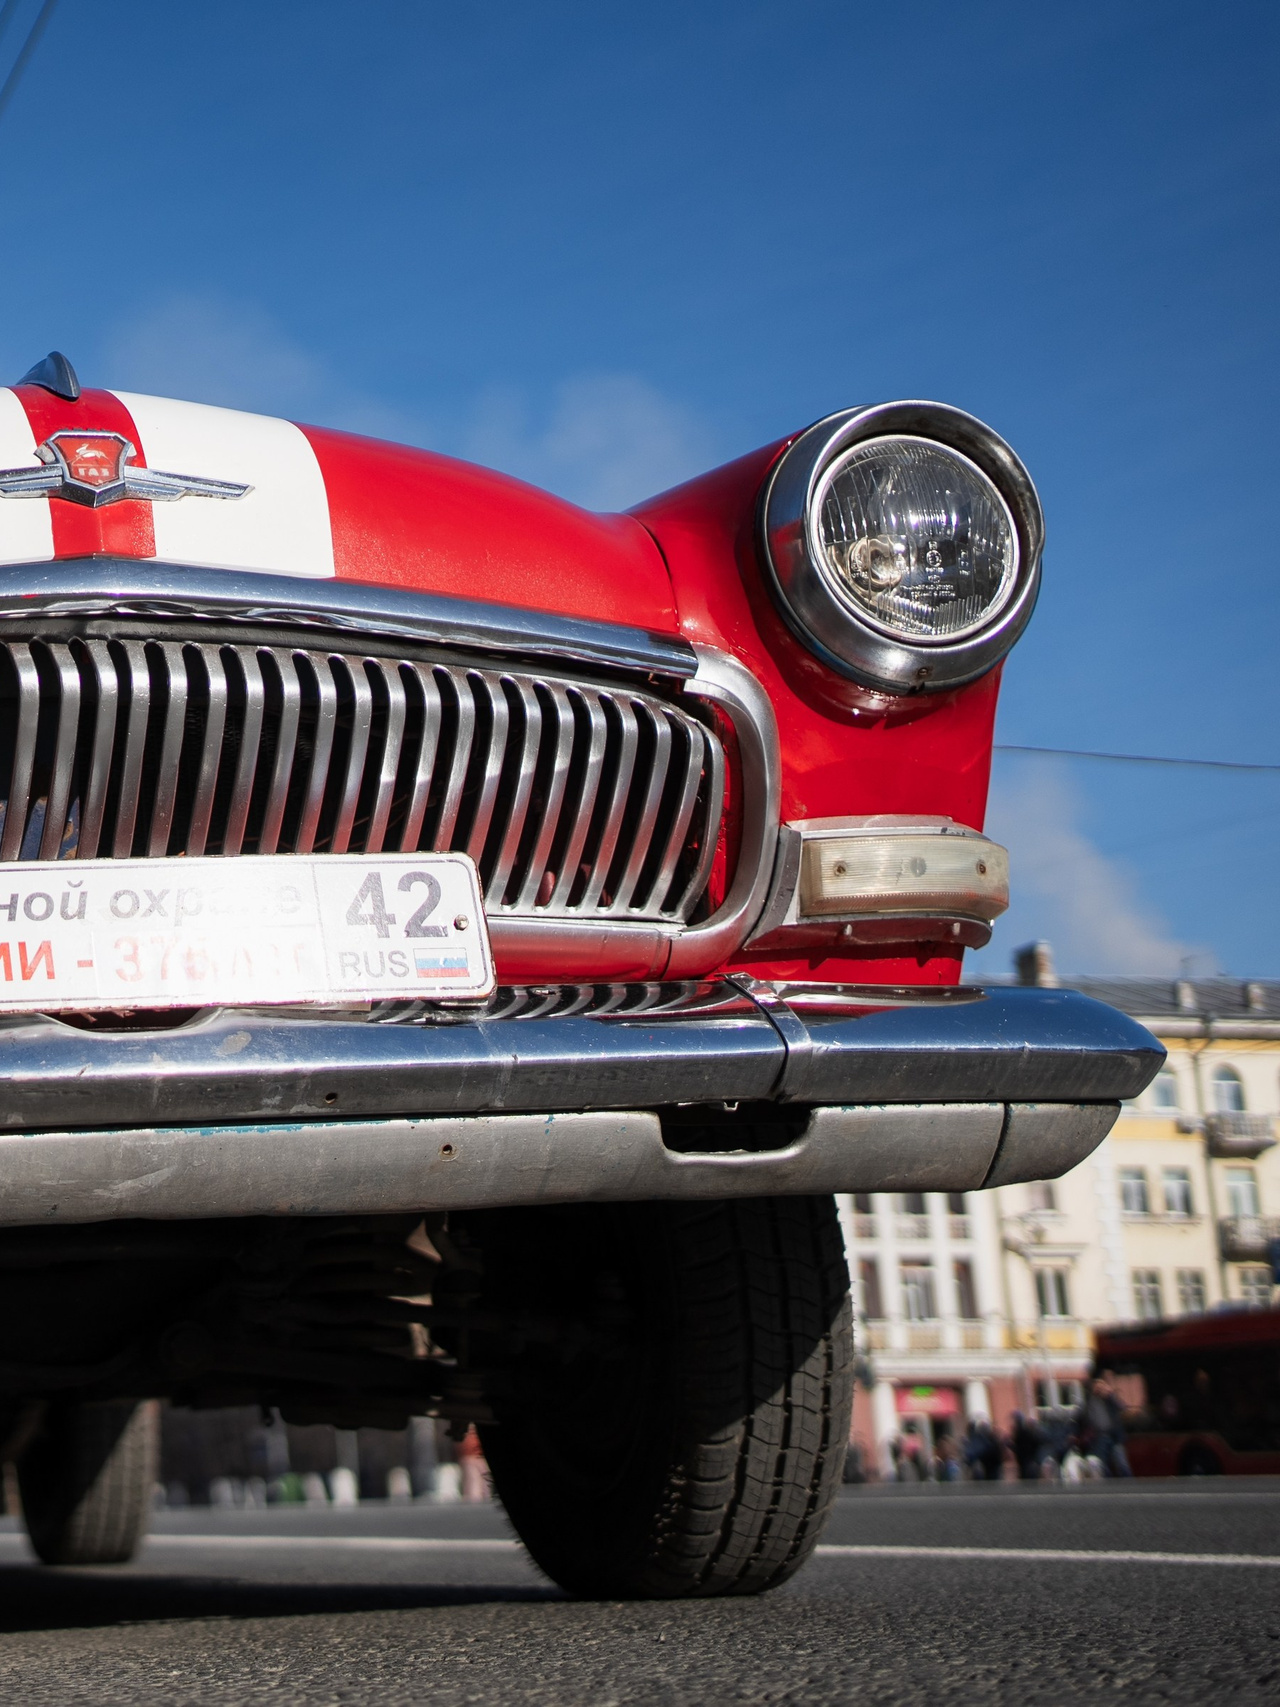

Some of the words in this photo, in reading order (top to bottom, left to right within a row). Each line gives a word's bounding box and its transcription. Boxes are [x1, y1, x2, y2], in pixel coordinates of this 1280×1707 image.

[109, 885, 303, 926] охре
[345, 871, 449, 939] 42
[340, 950, 410, 979] RUS
